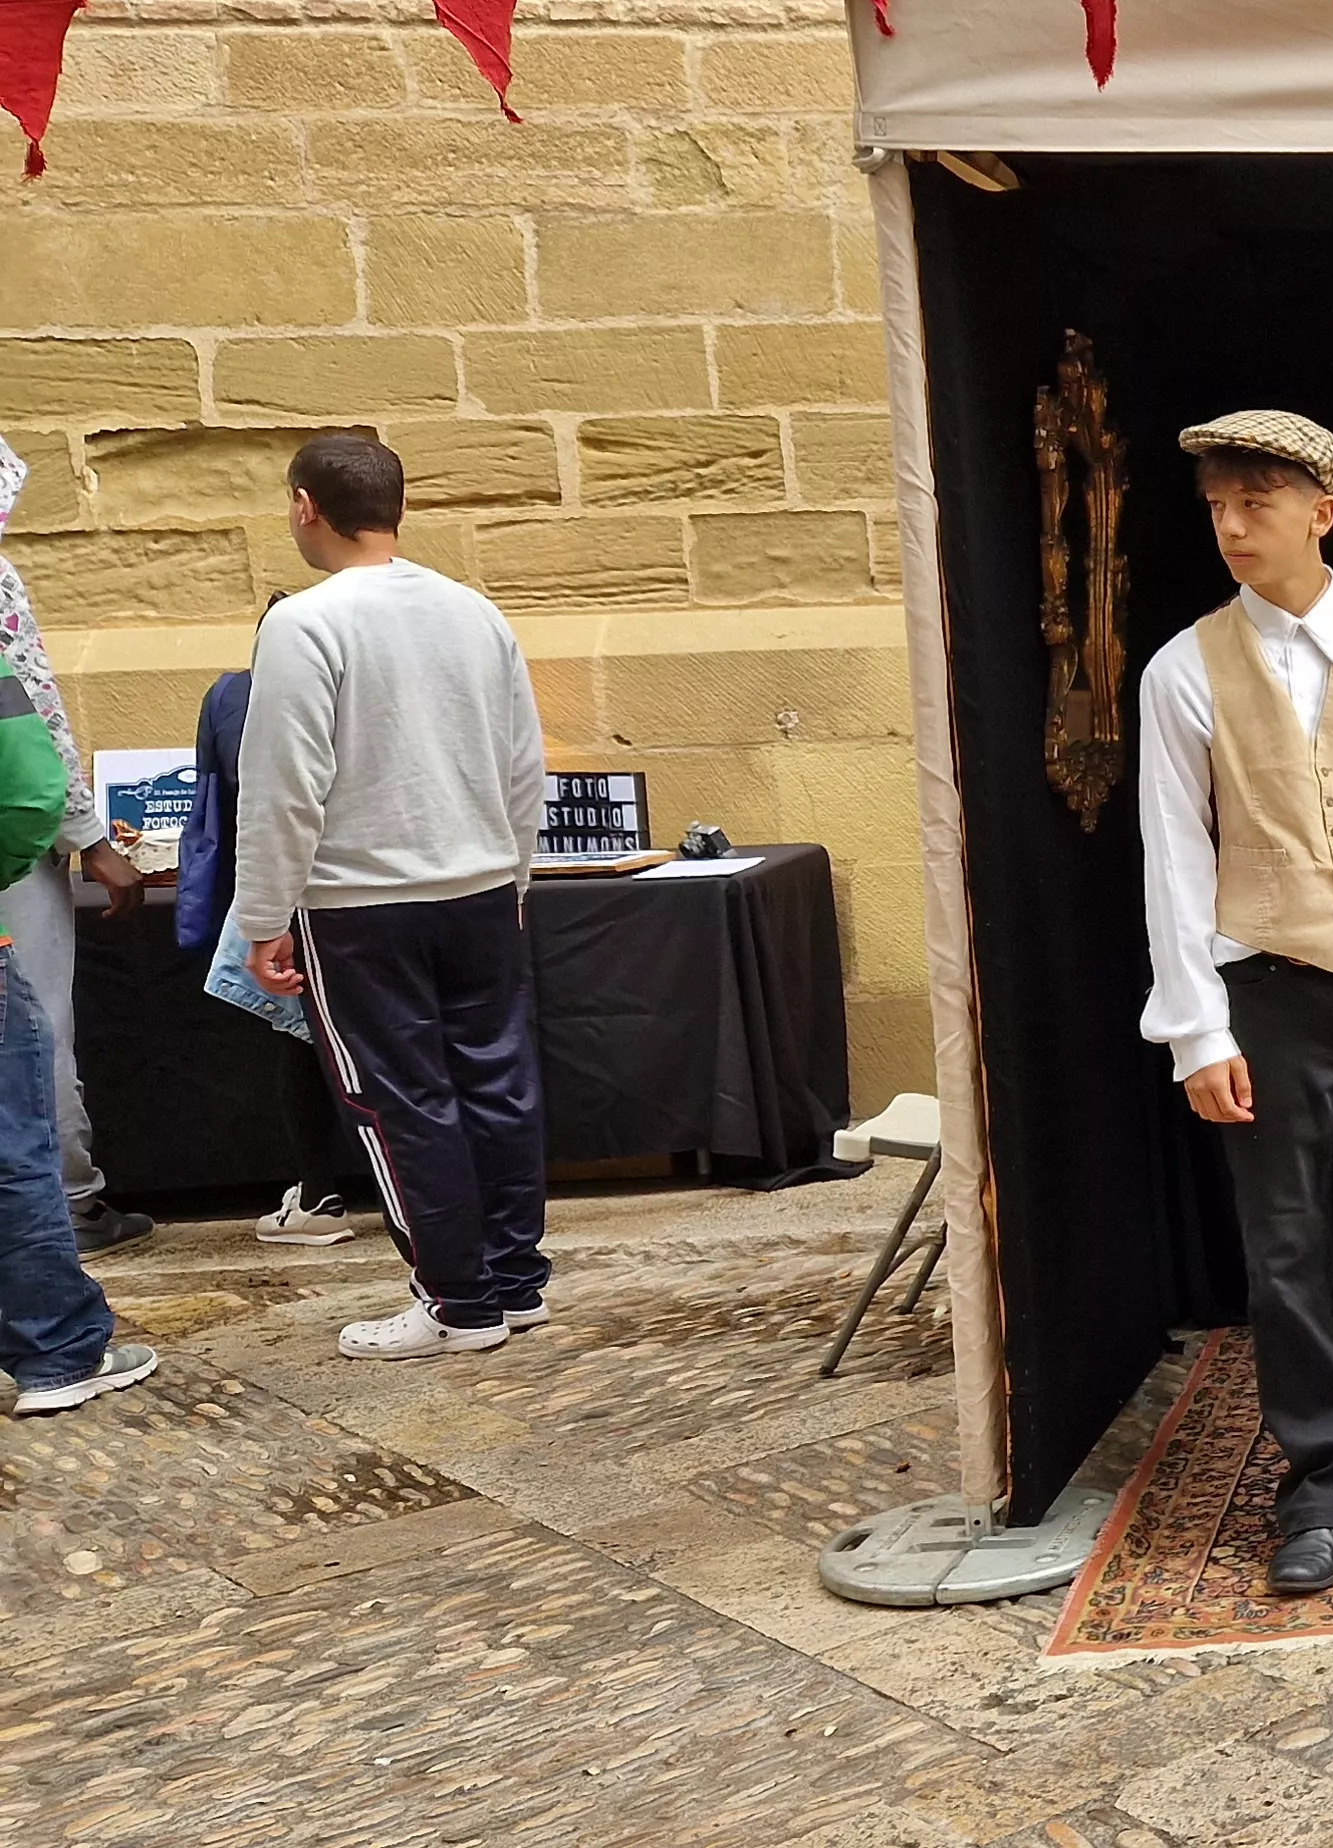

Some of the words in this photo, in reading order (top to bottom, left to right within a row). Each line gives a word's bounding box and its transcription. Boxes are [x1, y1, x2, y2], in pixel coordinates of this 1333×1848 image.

[558, 777, 608, 799] FOTO
[144, 799, 193, 814] ESTUD
[547, 805, 623, 828] STUDIO
